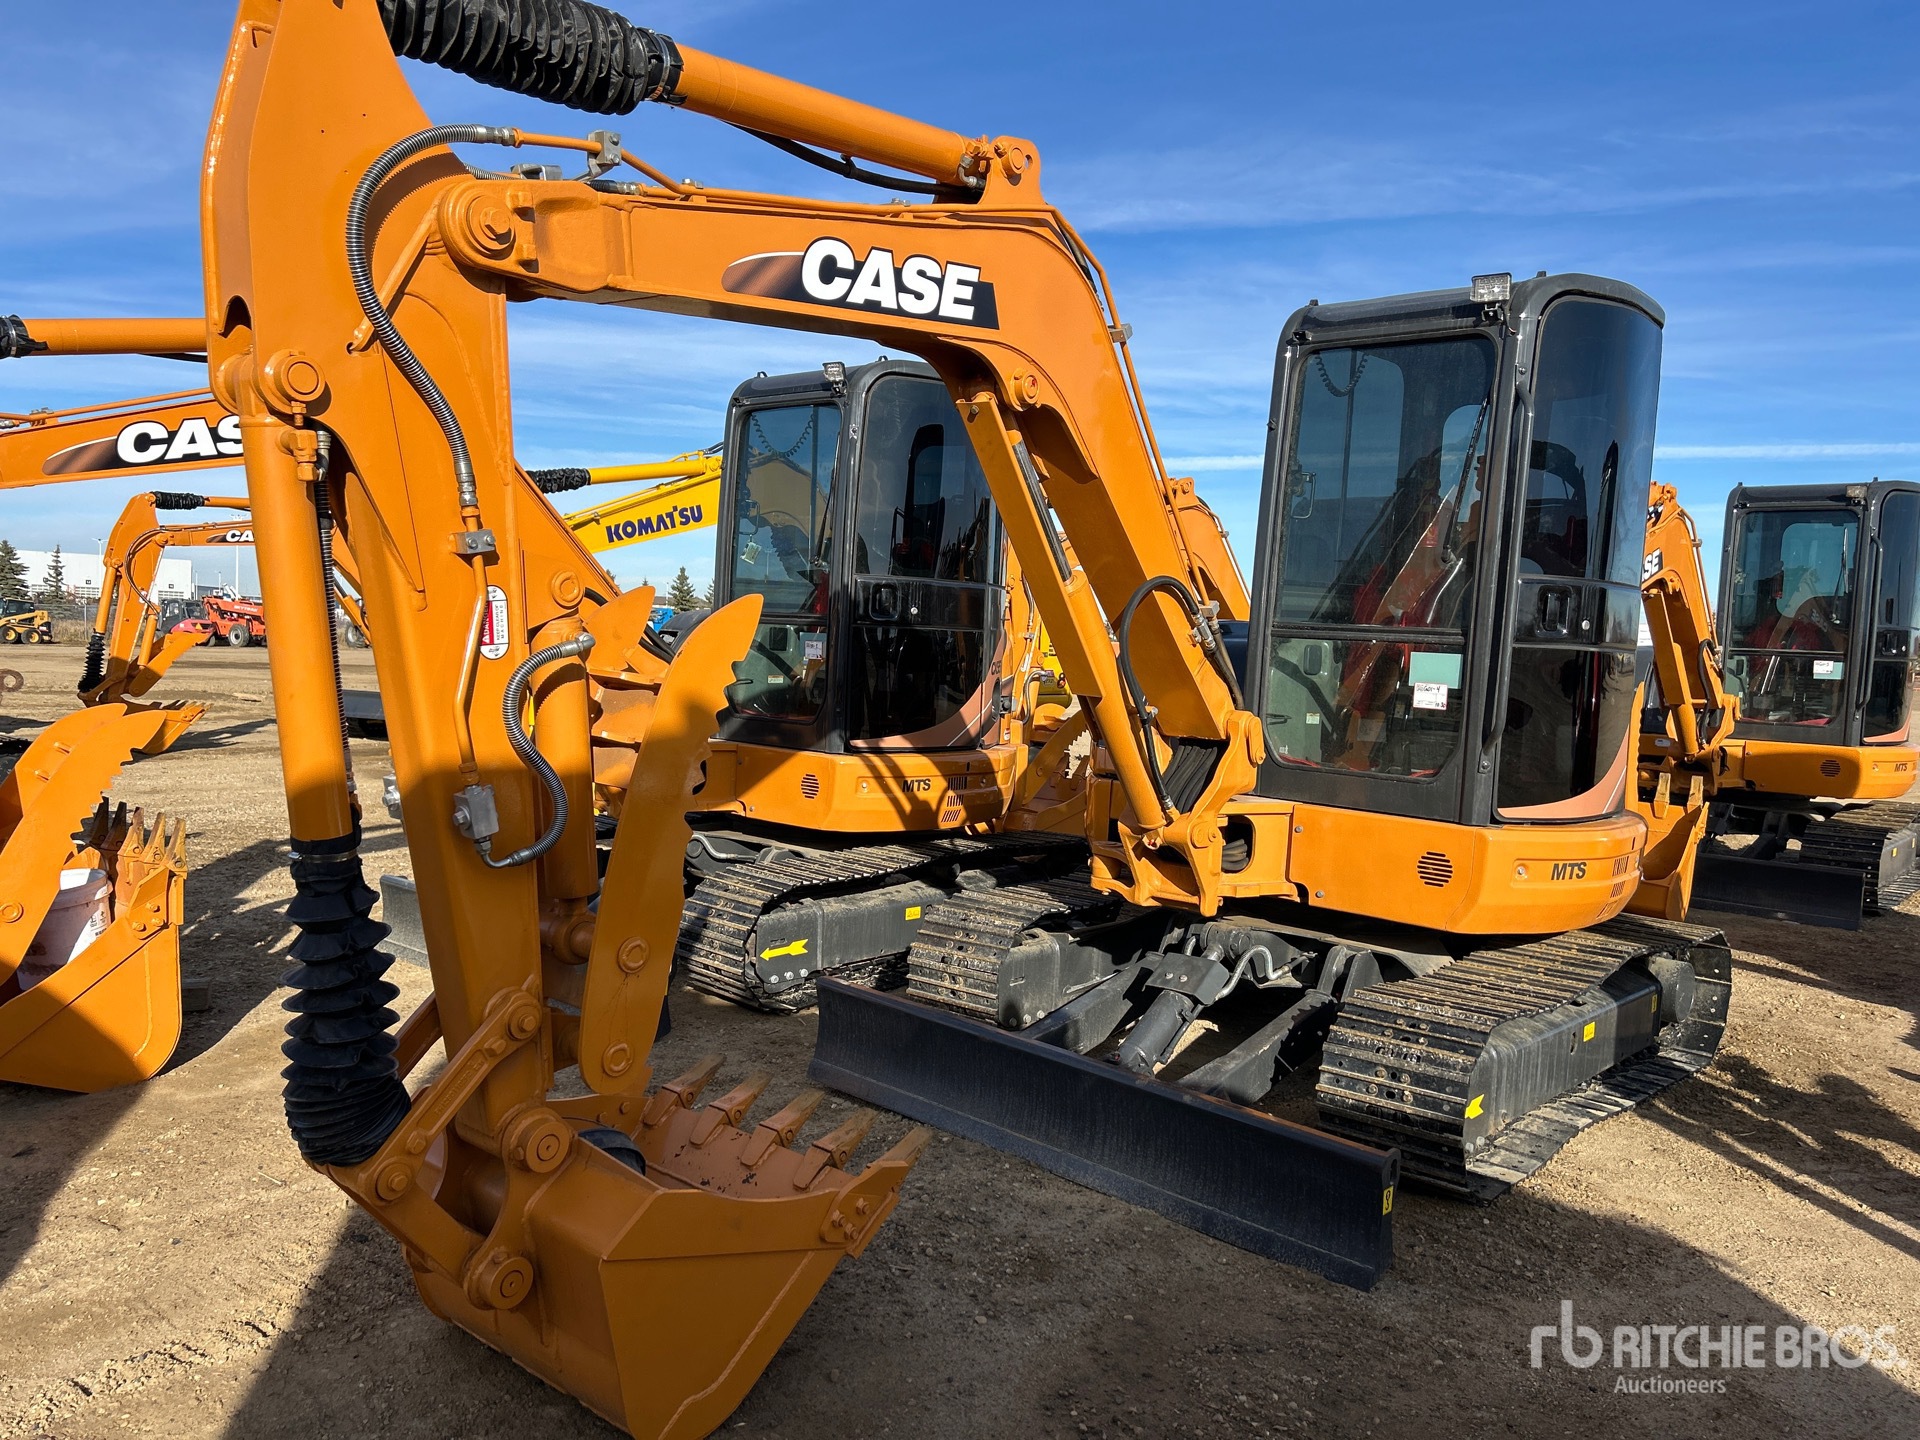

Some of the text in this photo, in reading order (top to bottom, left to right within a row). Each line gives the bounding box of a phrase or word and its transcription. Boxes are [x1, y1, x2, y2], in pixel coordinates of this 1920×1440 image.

[802, 239, 981, 320] CASE
[118, 417, 243, 464] CAS
[225, 529, 255, 542] CA
[606, 504, 703, 544] KOMATSU
[1642, 549, 1661, 581] SE
[1894, 763, 1908, 772] MTS
[902, 778, 931, 792] MTS
[1551, 861, 1586, 881] MTS
